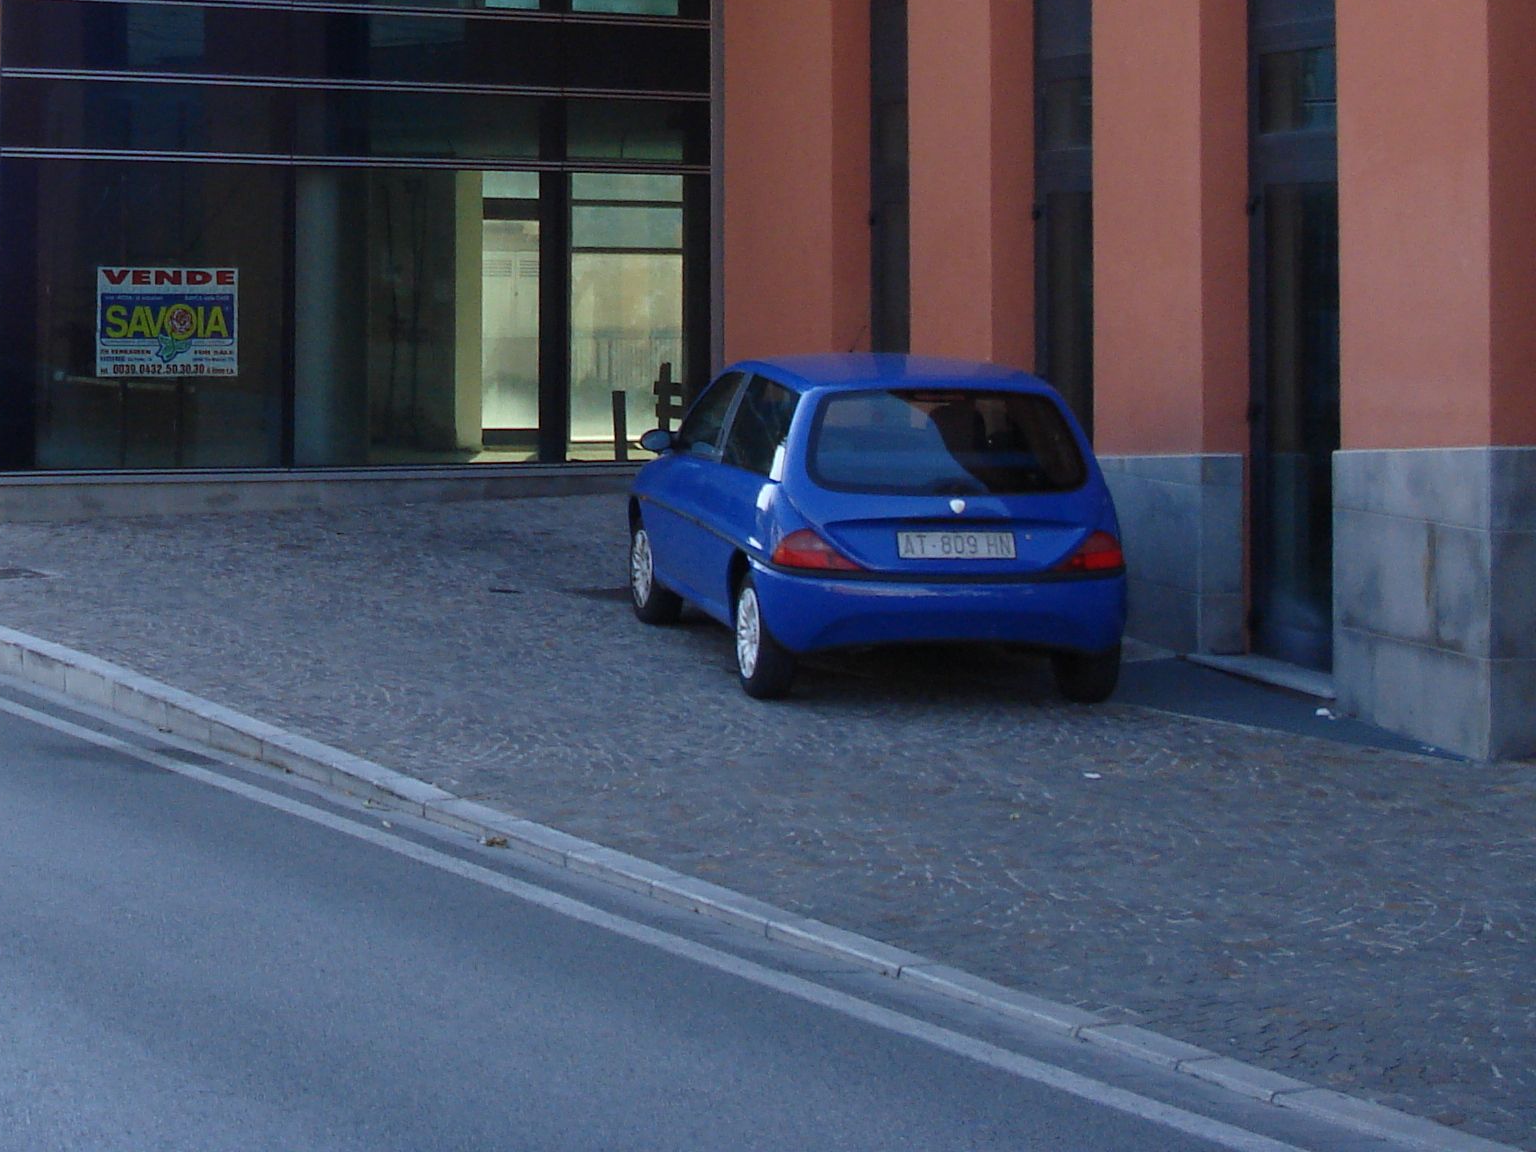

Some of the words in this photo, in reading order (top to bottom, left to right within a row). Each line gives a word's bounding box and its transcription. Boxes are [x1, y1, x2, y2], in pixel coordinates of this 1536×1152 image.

[102, 269, 235, 285] VENDE
[105, 303, 229, 340] SAVOIA
[902, 534, 930, 556] AT
[941, 535, 978, 555] 809
[987, 534, 1014, 556] HN
